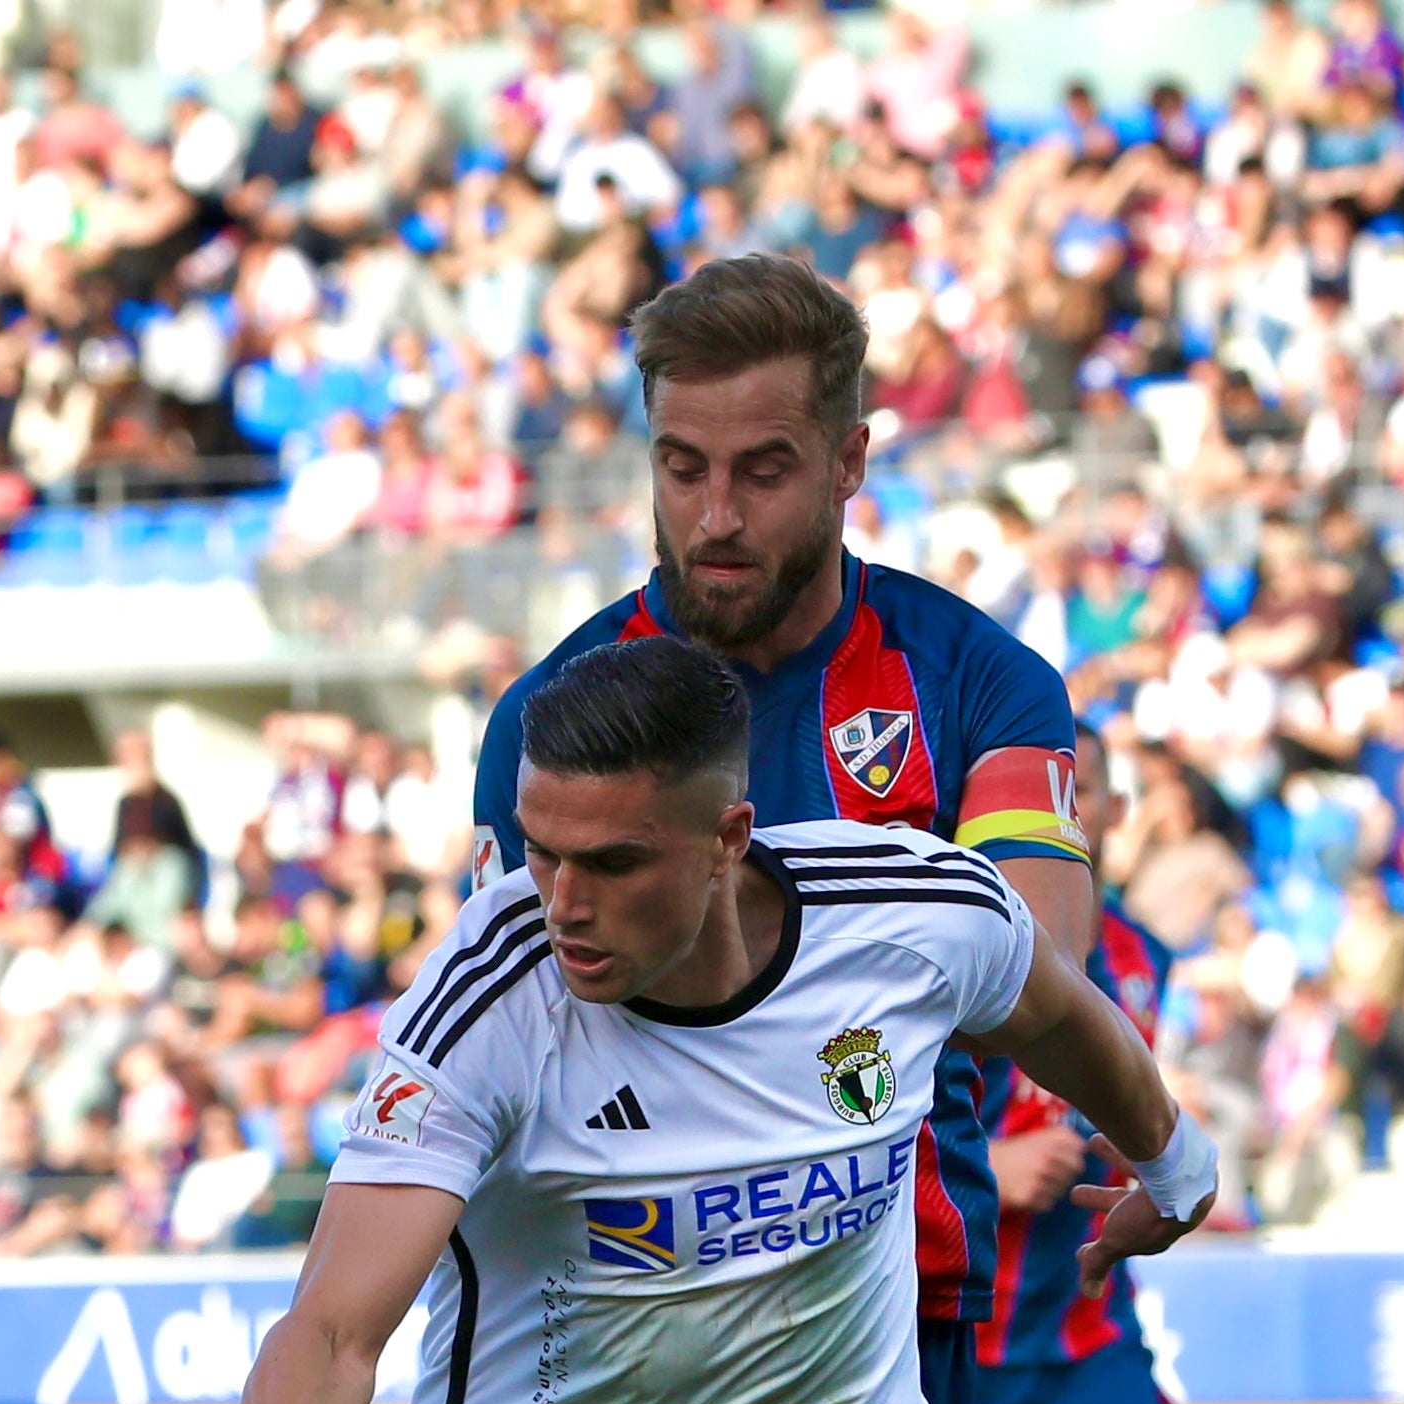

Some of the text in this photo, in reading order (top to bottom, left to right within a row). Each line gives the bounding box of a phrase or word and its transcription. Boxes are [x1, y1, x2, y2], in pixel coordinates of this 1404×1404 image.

[870, 720, 905, 754] HUESCA
[843, 1053, 867, 1068] CLUB
[830, 1083, 856, 1120] BURGOS
[881, 1066, 893, 1105] FUTBOL
[693, 1135, 915, 1232] REALE
